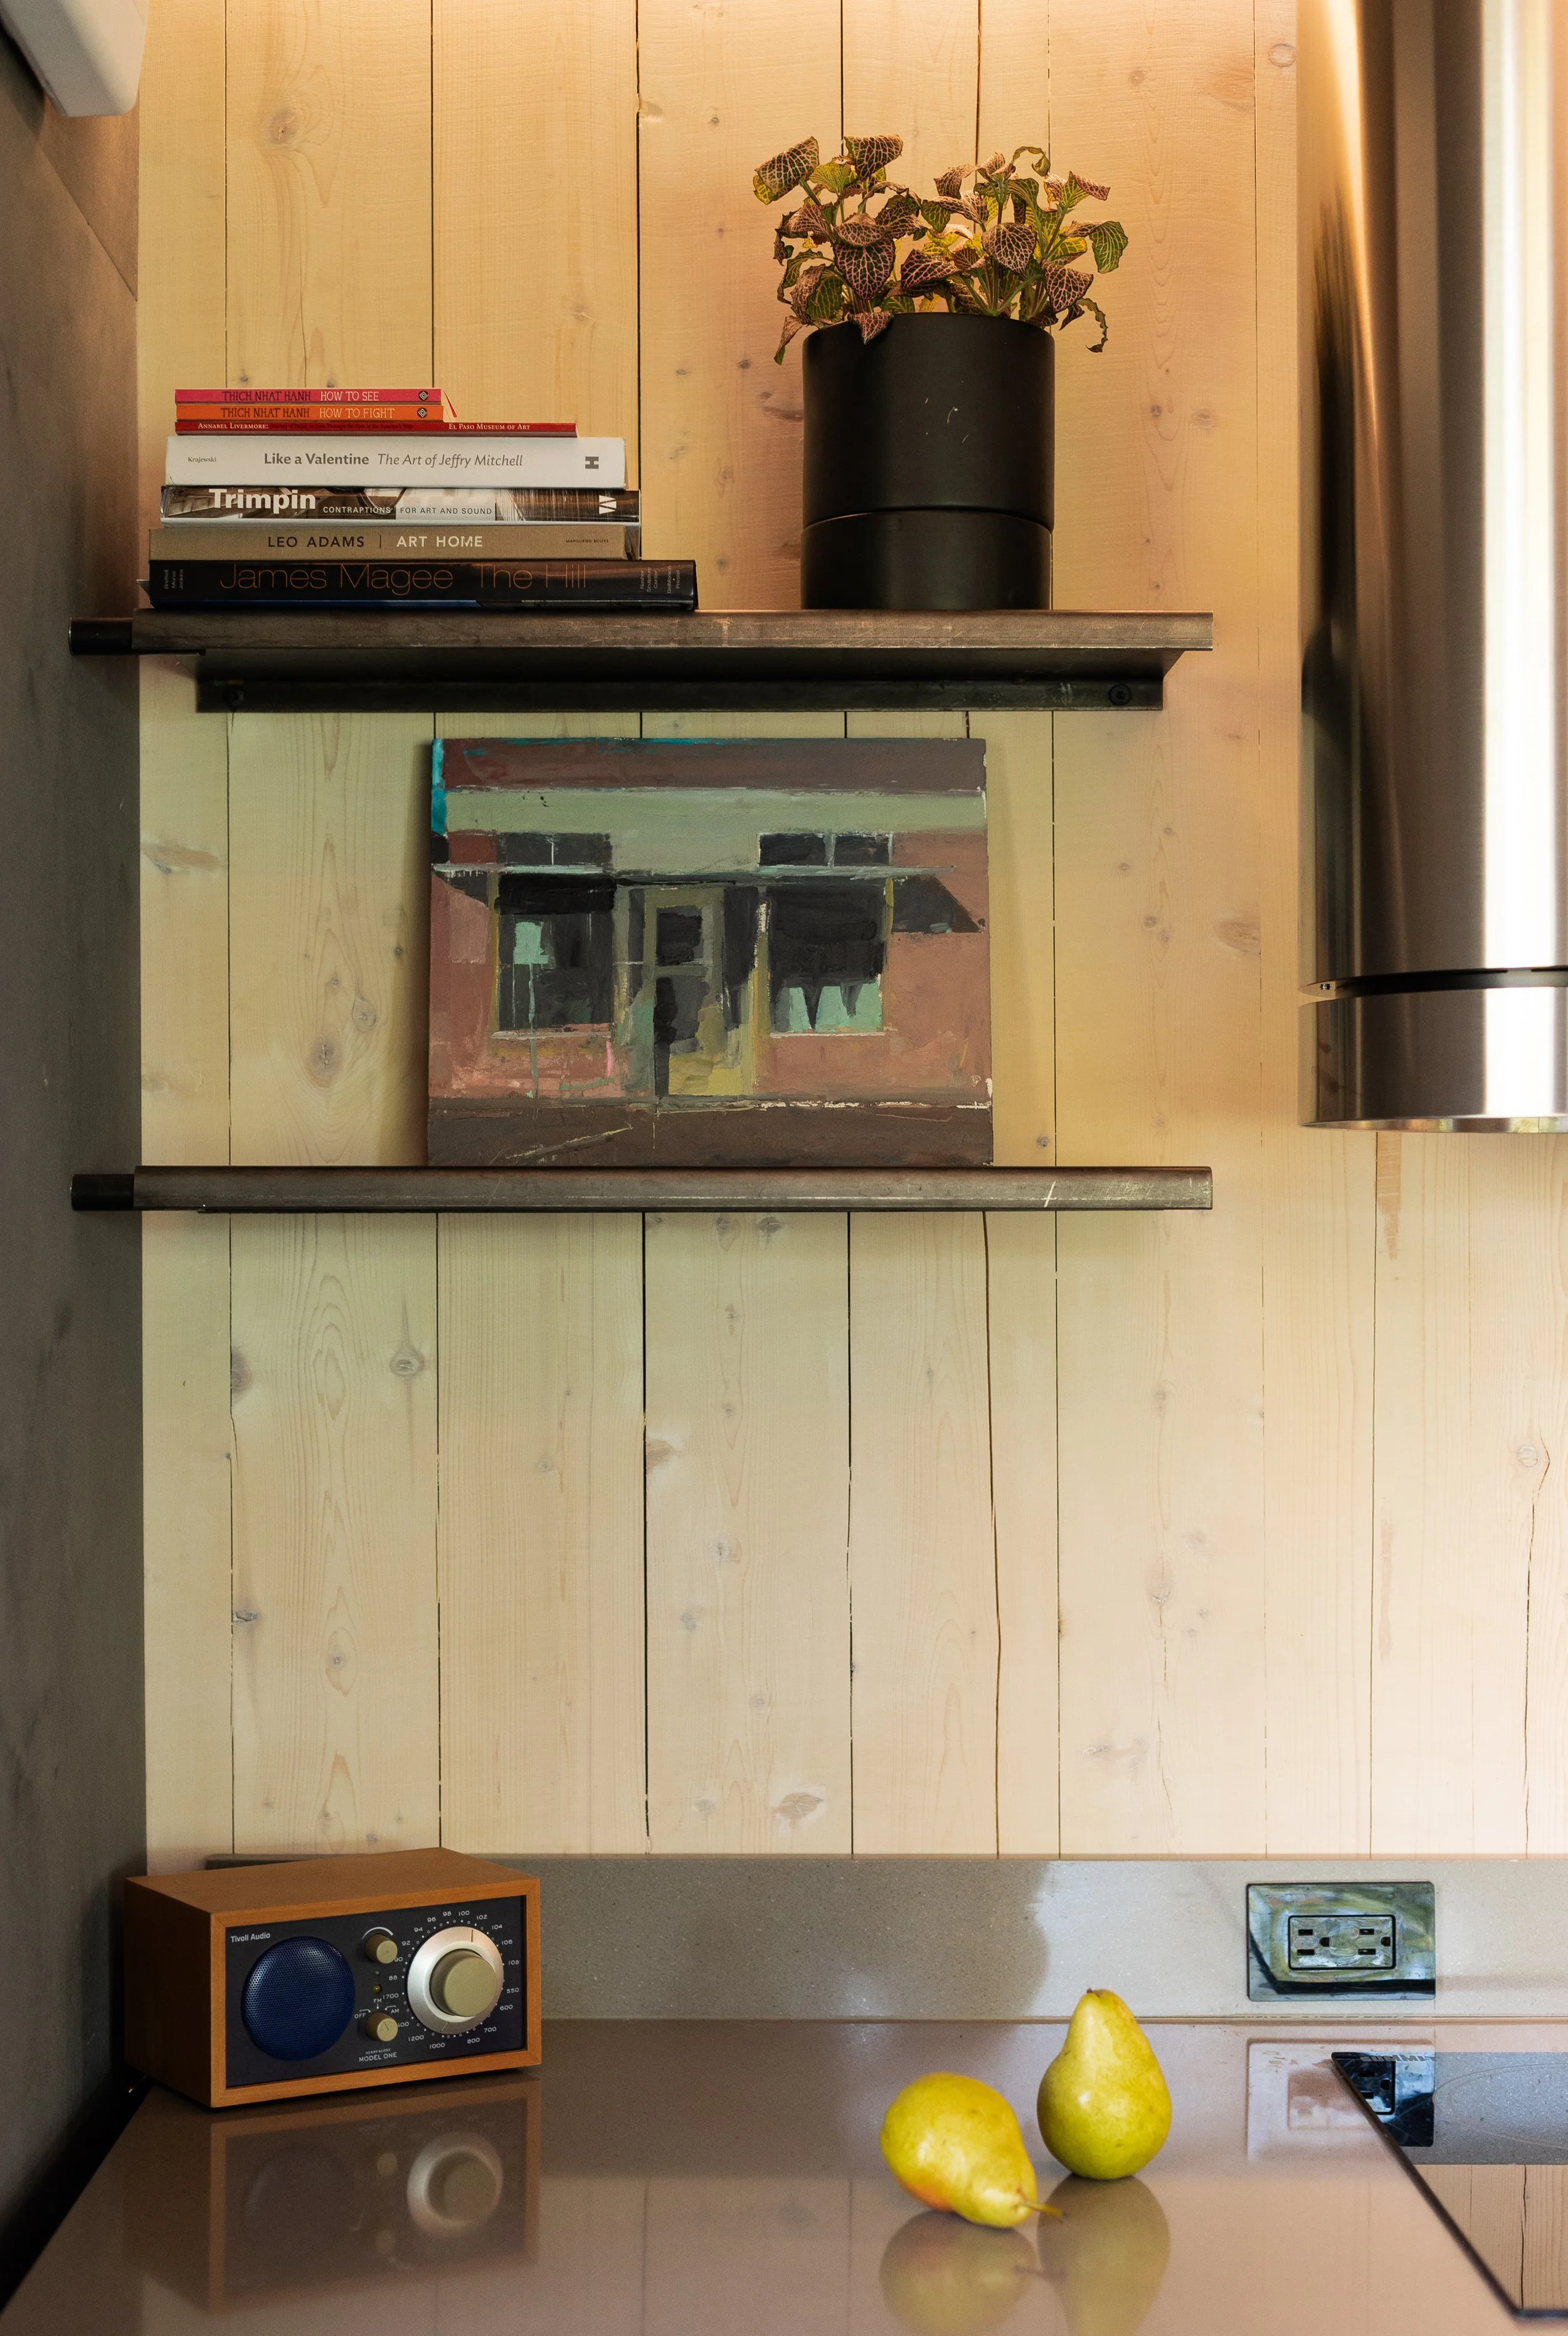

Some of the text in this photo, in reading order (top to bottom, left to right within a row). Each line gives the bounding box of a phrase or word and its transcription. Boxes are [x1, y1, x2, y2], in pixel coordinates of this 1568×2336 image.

[222, 391, 311, 401] THICH NHAT HANH
[320, 391, 379, 401] HOW TO SEE
[221, 407, 310, 418] THICH NHAT HANH
[319, 408, 395, 419] HOW TO FIGHT
[264, 453, 523, 469] Like a Valentine The Art of Jeffry Mitchell
[208, 488, 393, 514] Trimpin CONTRAPTIONS
[268, 536, 364, 548] LEO ADAMS
[396, 536, 483, 548] ART HOME
[220, 564, 586, 596] James Magee The Hill
[230, 1932, 271, 1943] Tivoli Audio
